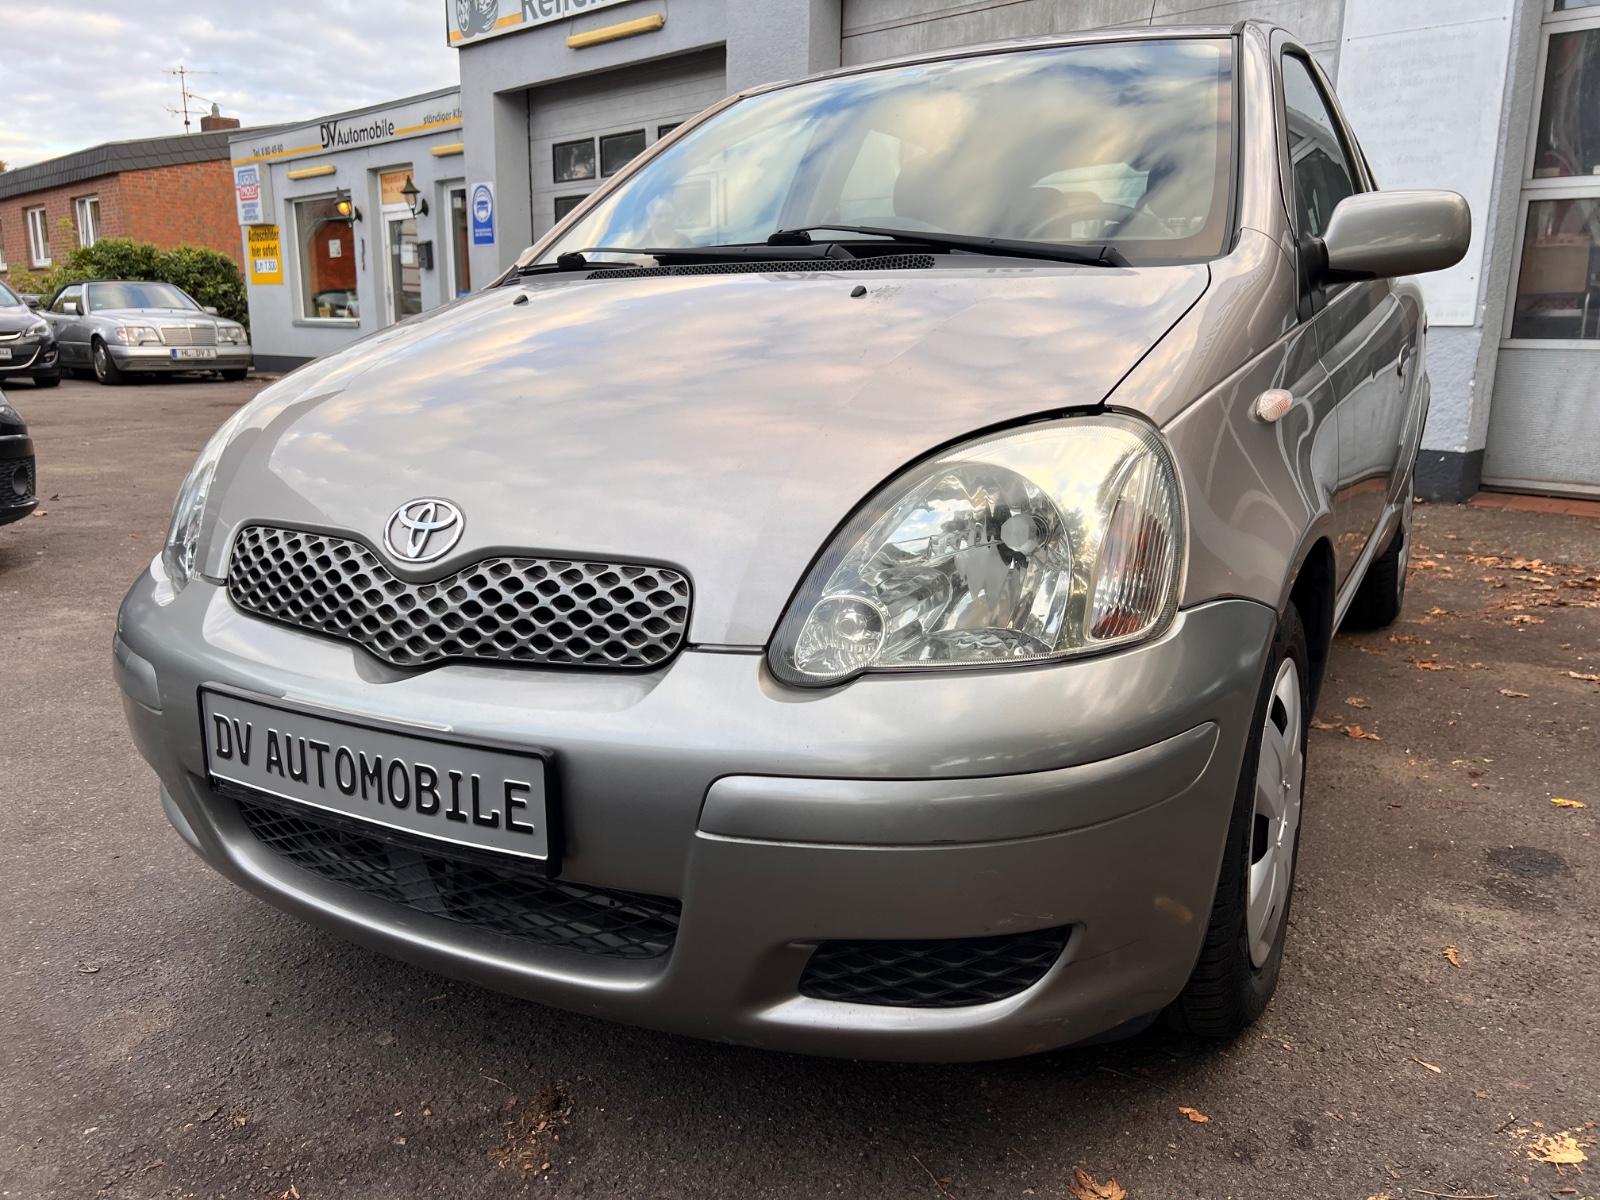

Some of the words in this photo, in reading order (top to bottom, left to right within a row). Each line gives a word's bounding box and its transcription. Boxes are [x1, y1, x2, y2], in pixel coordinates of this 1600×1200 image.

[337, 118, 395, 146] Automobile
[248, 227, 279, 242] Autoschilder
[251, 244, 262, 257] hier
[263, 243, 278, 257] sofort
[213, 712, 253, 766] DV
[265, 728, 535, 835] AUTOMOBILE
